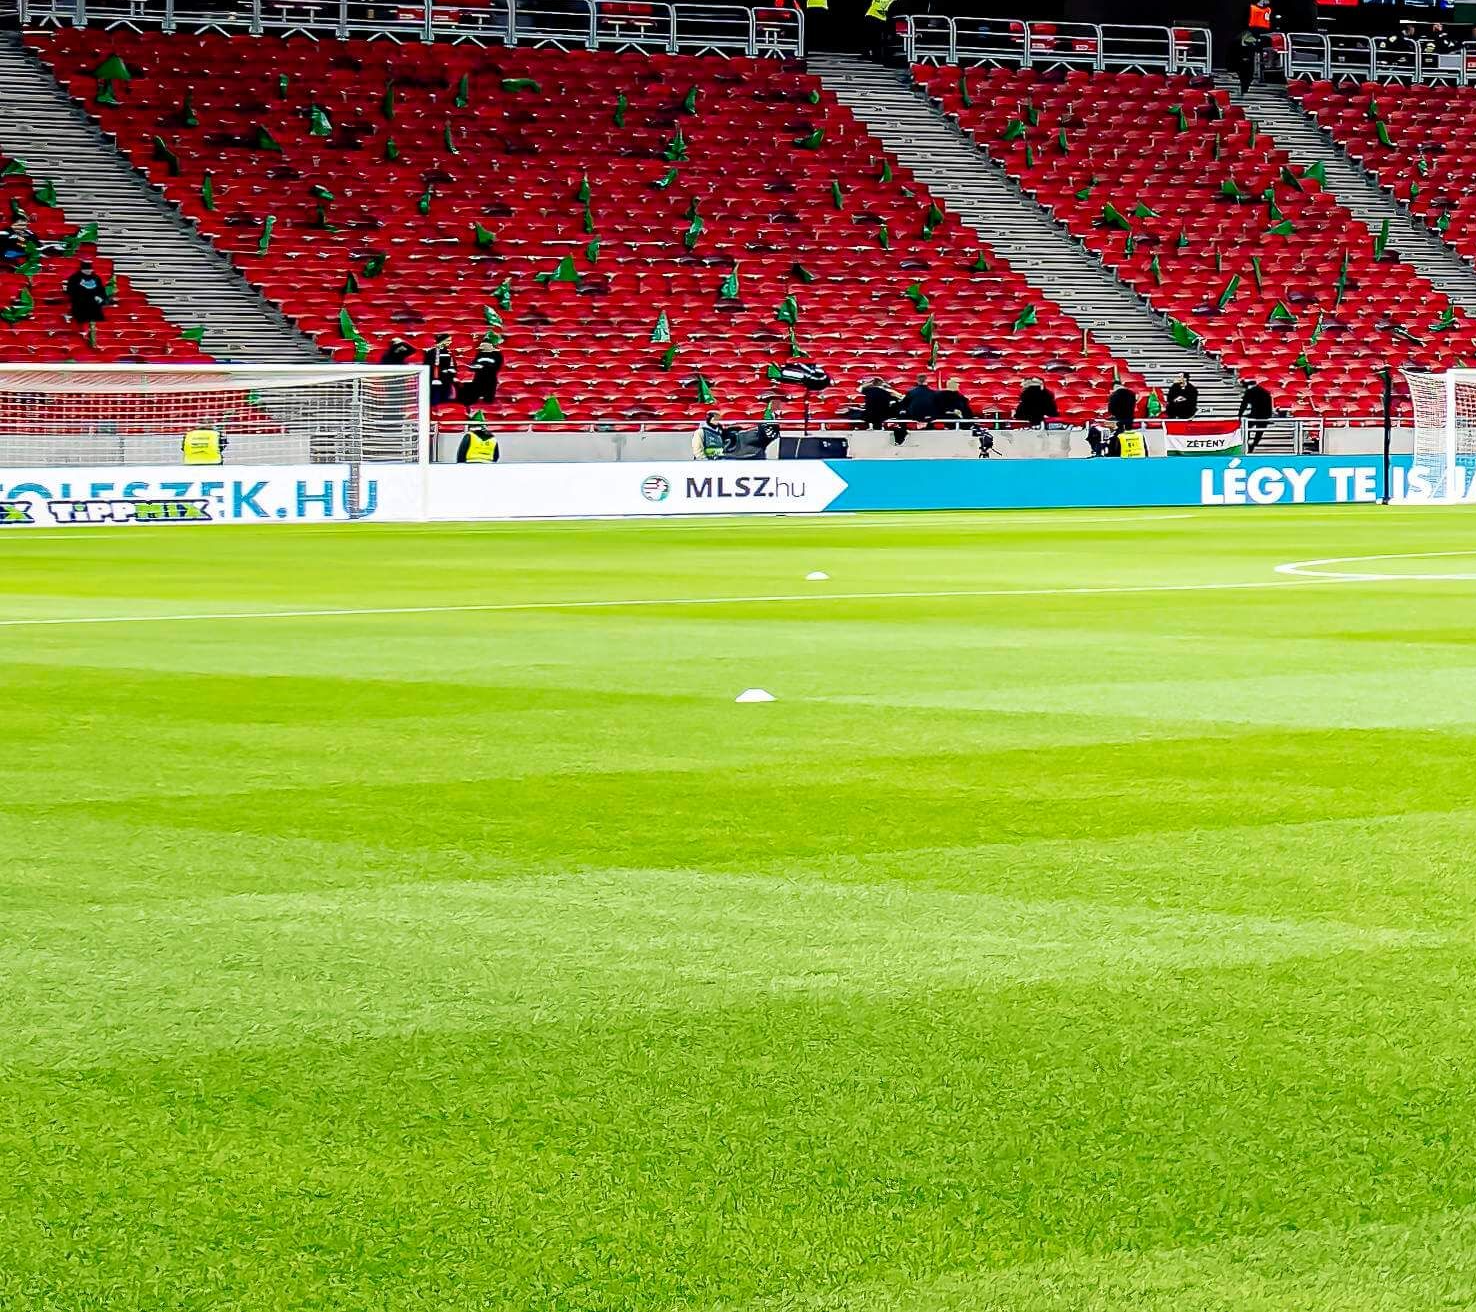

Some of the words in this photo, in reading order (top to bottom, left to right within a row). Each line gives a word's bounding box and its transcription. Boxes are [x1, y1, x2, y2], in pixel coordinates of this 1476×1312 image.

[686, 476, 805, 498] MLSZ.hu
[1201, 457, 1318, 504] LÉGY
[1329, 467, 1378, 503] TE
[1393, 465, 1436, 500] IS
